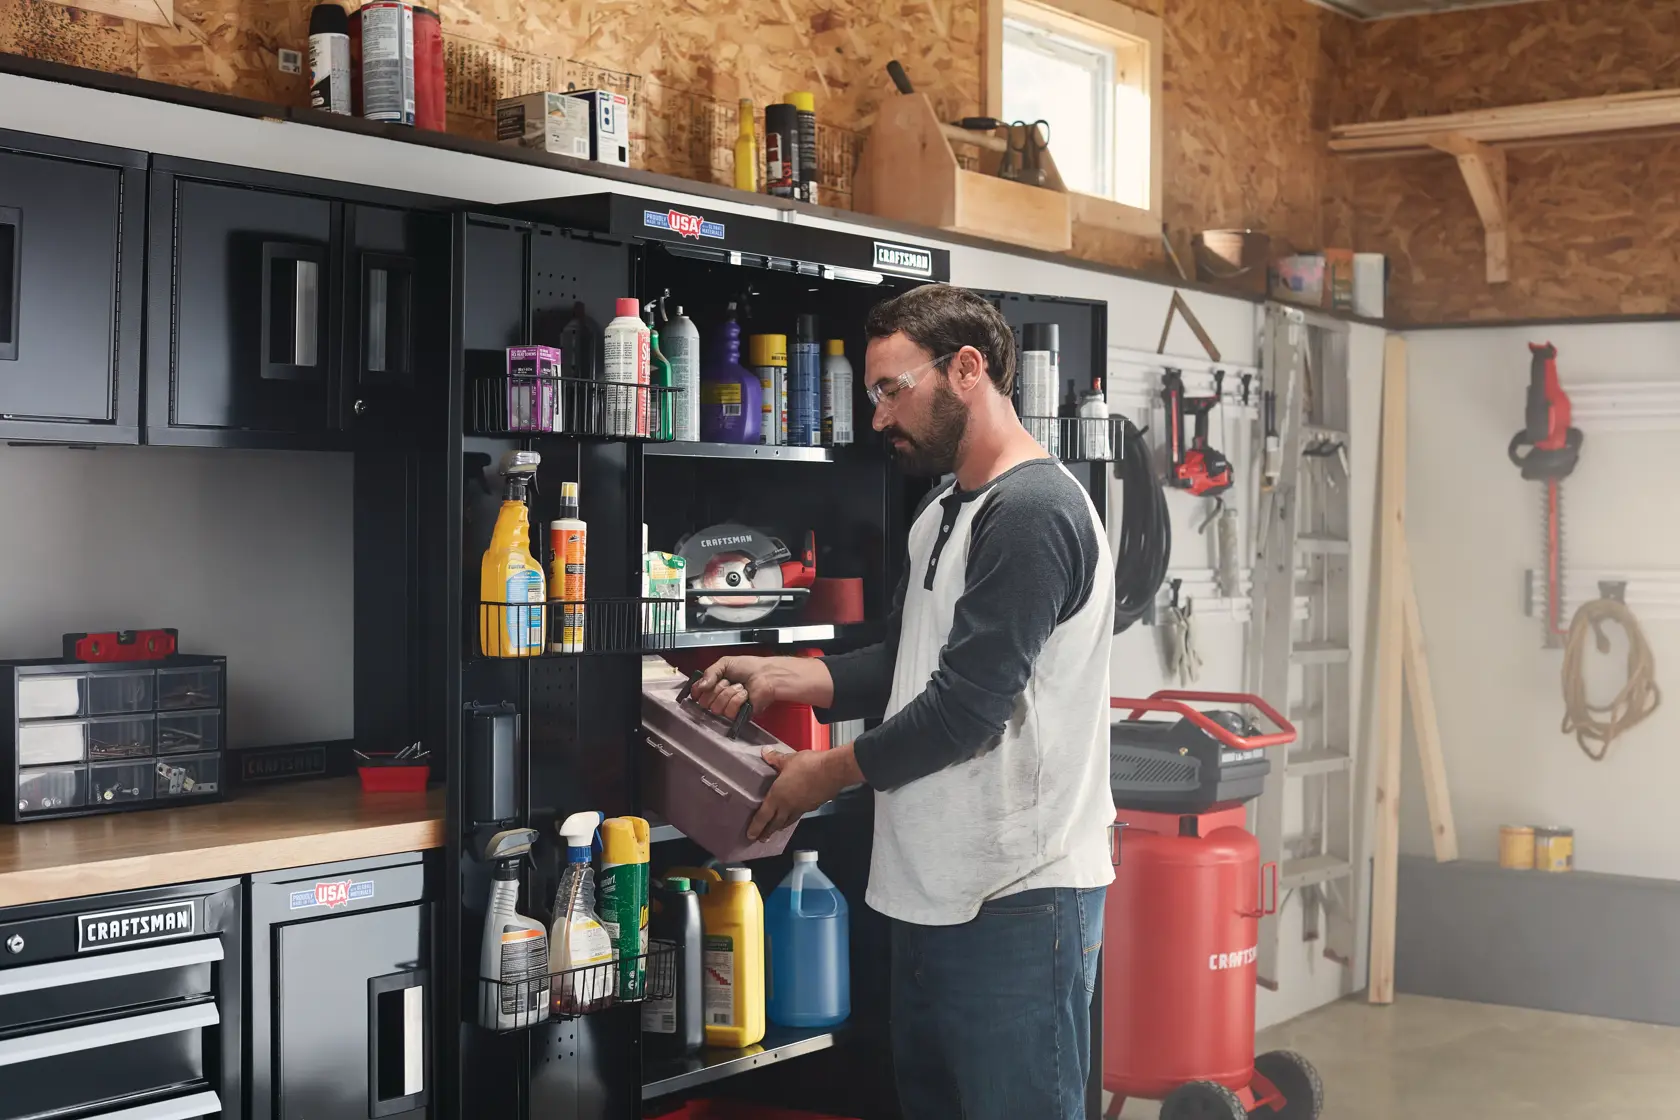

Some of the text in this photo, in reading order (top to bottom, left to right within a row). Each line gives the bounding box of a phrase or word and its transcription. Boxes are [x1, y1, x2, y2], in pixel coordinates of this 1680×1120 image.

[646, 212, 667, 222] PROUDLY
[671, 214, 699, 233] USA
[701, 228, 723, 237] MATERIALS
[878, 248, 928, 269] CRAFTSMAN
[701, 535, 753, 548] CRAFTSMAN
[319, 884, 347, 902] USA
[87, 910, 188, 942] CRAFTSMAN
